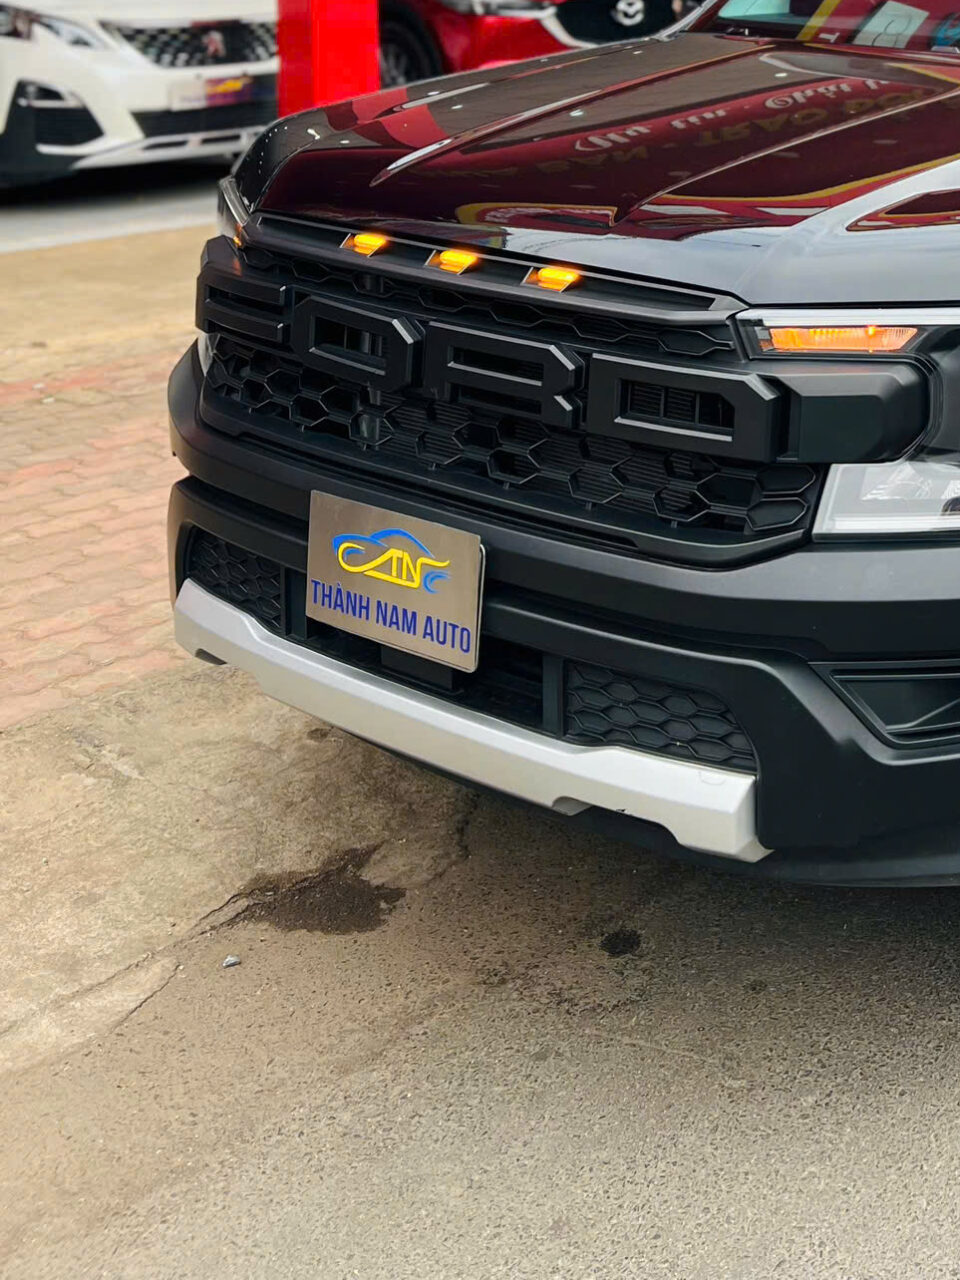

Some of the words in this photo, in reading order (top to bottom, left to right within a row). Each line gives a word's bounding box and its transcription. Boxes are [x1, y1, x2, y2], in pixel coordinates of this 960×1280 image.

[310, 578, 371, 621] THÀNH
[375, 599, 418, 636] NAM
[422, 615, 472, 654] AUTO
